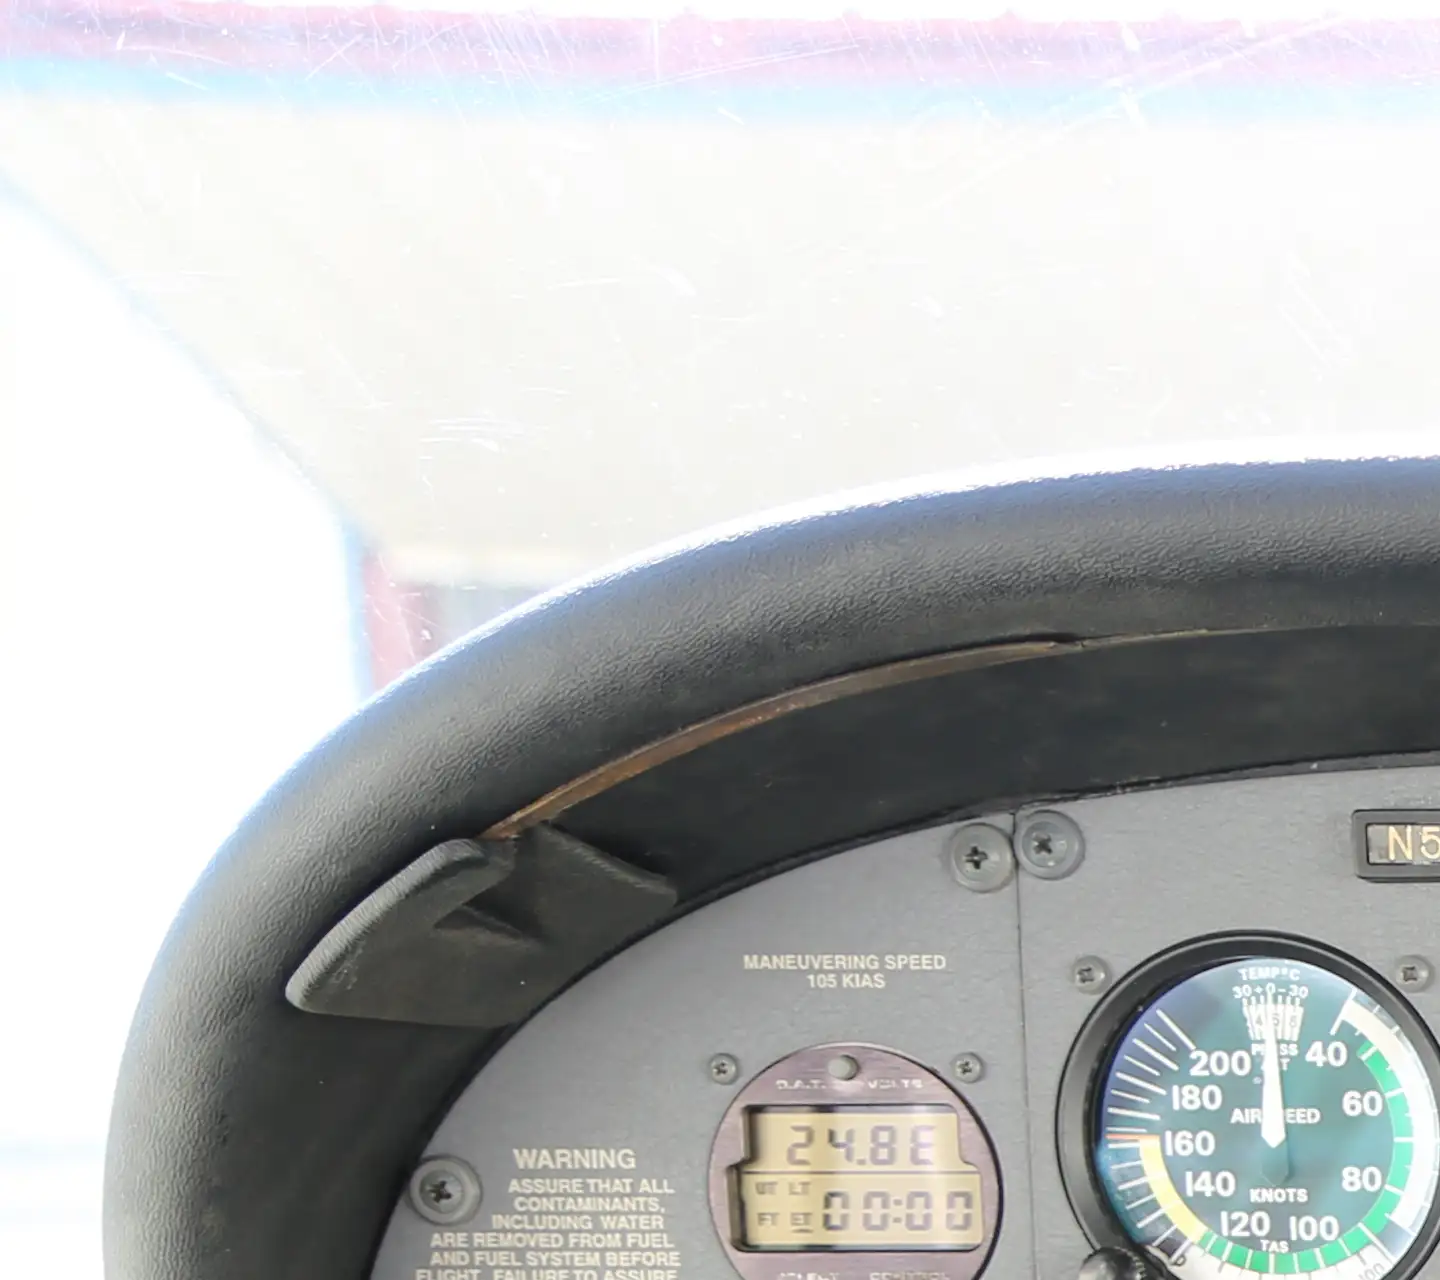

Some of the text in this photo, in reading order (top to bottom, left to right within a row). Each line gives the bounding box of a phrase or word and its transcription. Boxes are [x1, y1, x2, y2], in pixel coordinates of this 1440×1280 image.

[743, 954, 947, 970] MANEUVERING SPEED
[806, 972, 886, 989] 105 KIAS
[512, 1148, 637, 1170] WARNING
[1249, 1187, 1308, 1203] KNOTS
